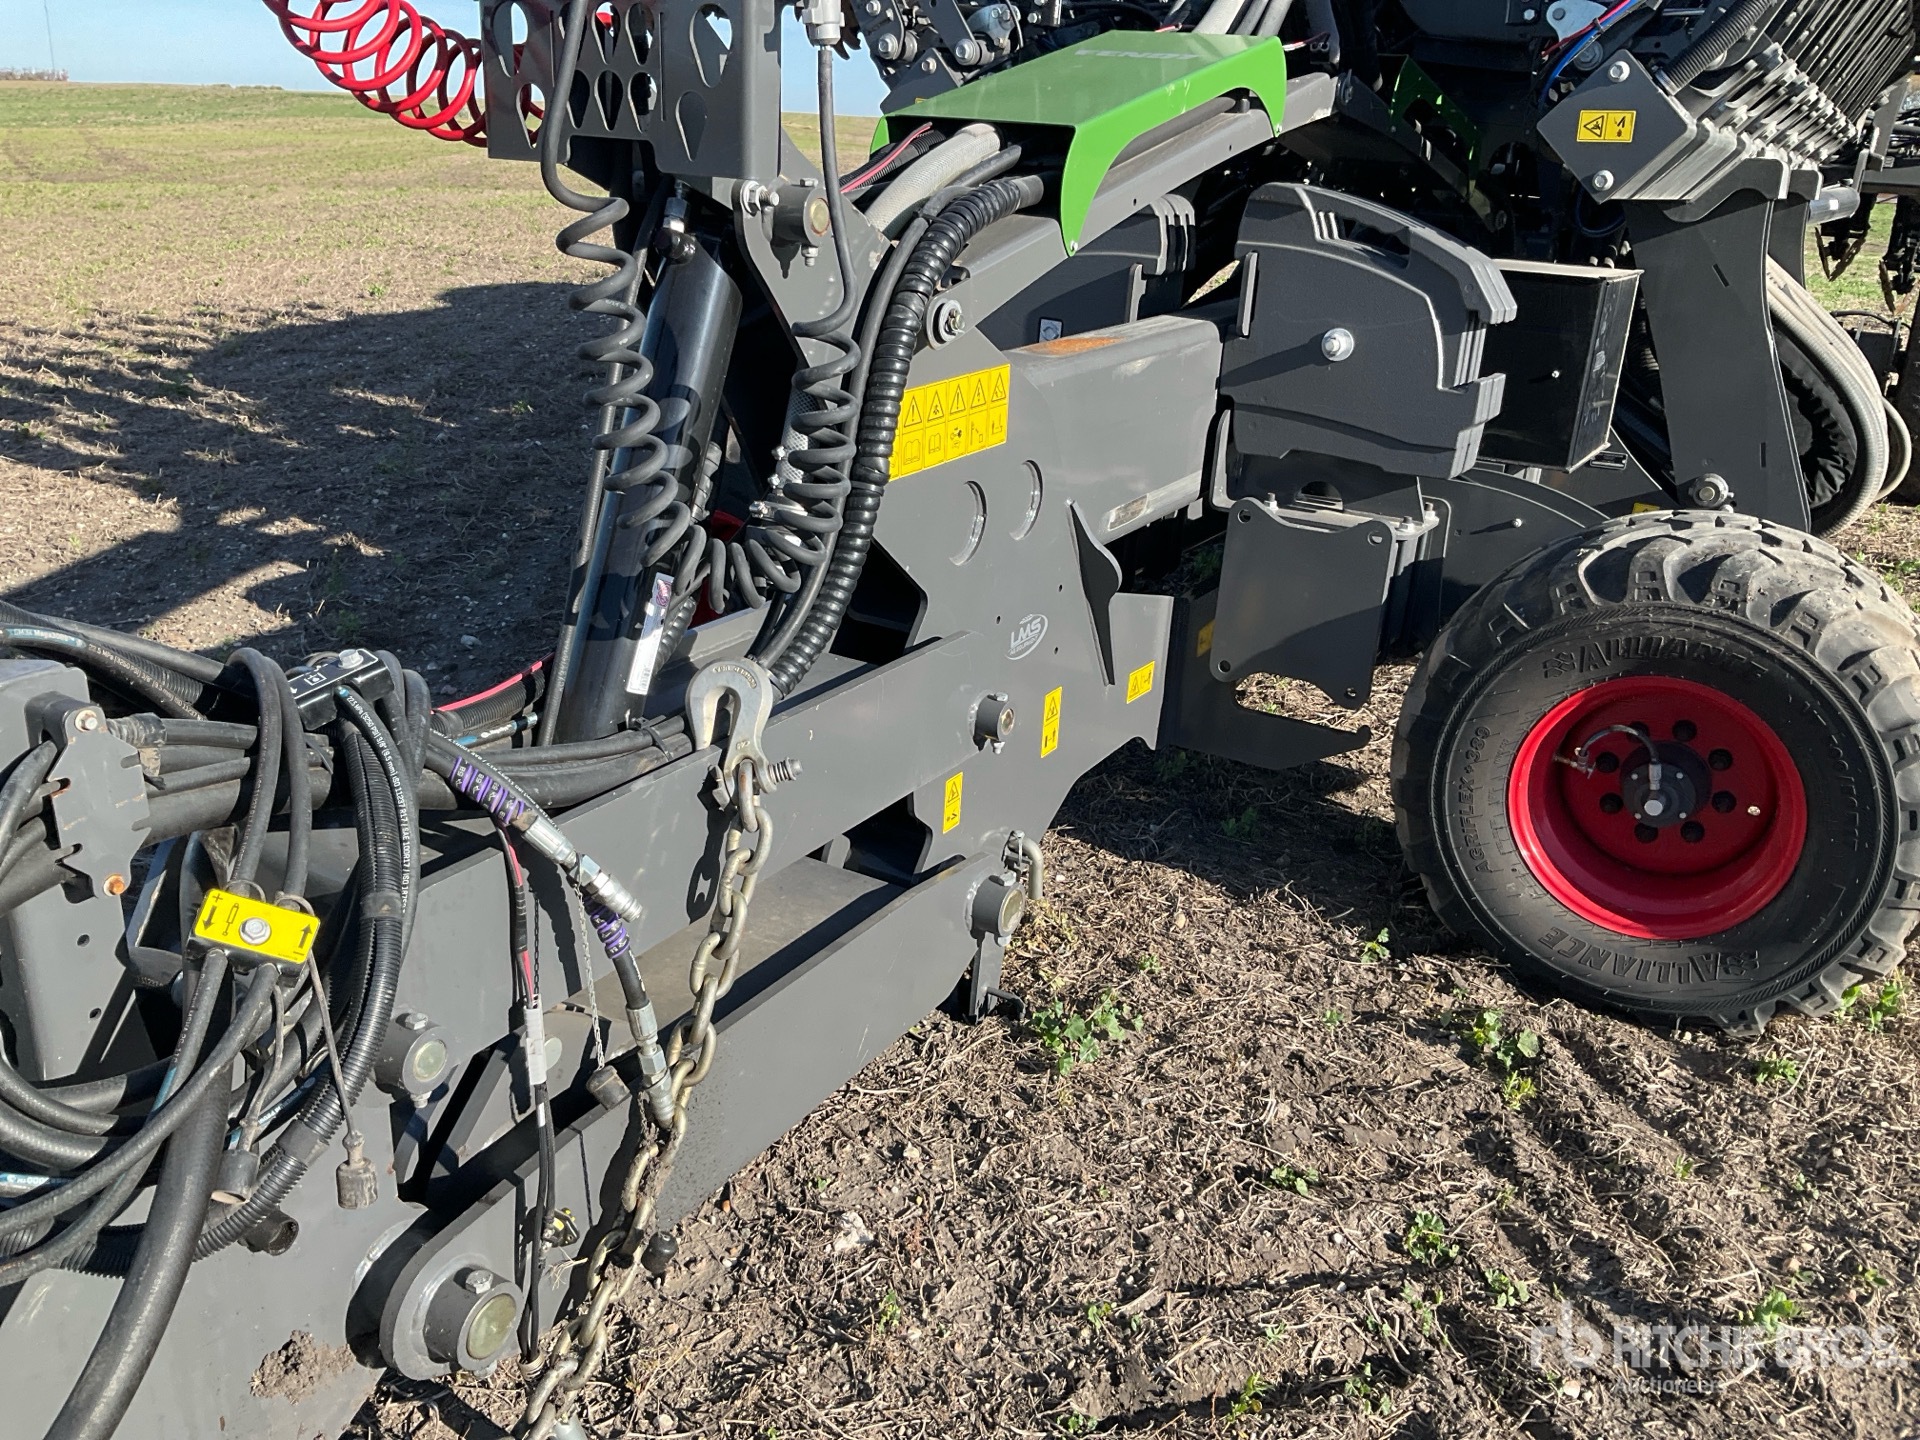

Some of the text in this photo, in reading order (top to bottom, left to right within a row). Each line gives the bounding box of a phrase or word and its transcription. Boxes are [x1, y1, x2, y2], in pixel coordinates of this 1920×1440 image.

[1011, 617, 1041, 649] LMS
[347, 696, 357, 707] 22.5
[354, 703, 364, 715] MPa
[361, 712, 374, 728] (3250
[370, 725, 382, 738] PSI)
[382, 748, 393, 761] (9.5
[392, 776, 401, 787] ISO
[395, 787, 406, 808] 11237
[400, 808, 408, 821] R17
[402, 827, 410, 841] SAE
[402, 841, 411, 867] 100R17
[402, 873, 410, 885] ISO
[1538, 927, 1720, 983] ALLIANCE
